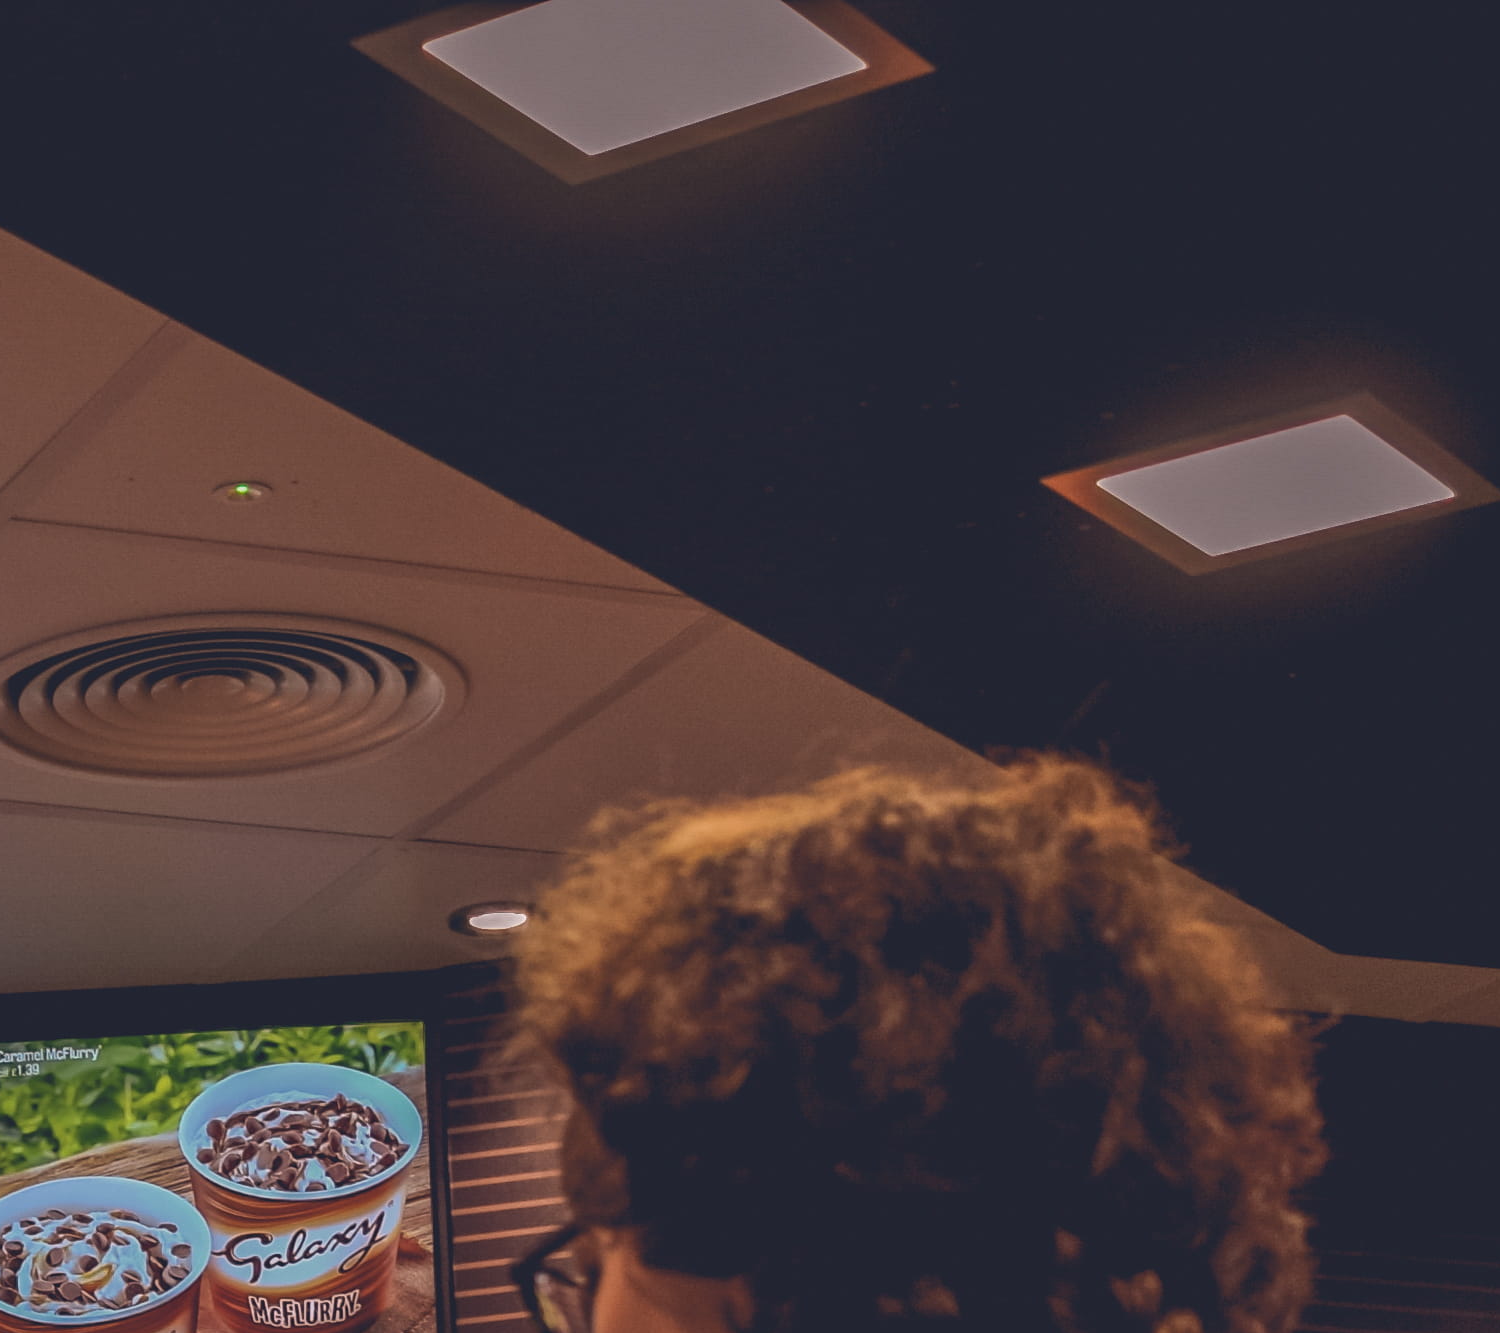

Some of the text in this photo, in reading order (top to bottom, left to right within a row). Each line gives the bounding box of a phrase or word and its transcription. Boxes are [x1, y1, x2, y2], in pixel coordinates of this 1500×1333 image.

[45, 1046, 99, 1062] McFlurry
[11, 1063, 40, 1078] £1.39
[211, 1211, 387, 1284] Galaxy
